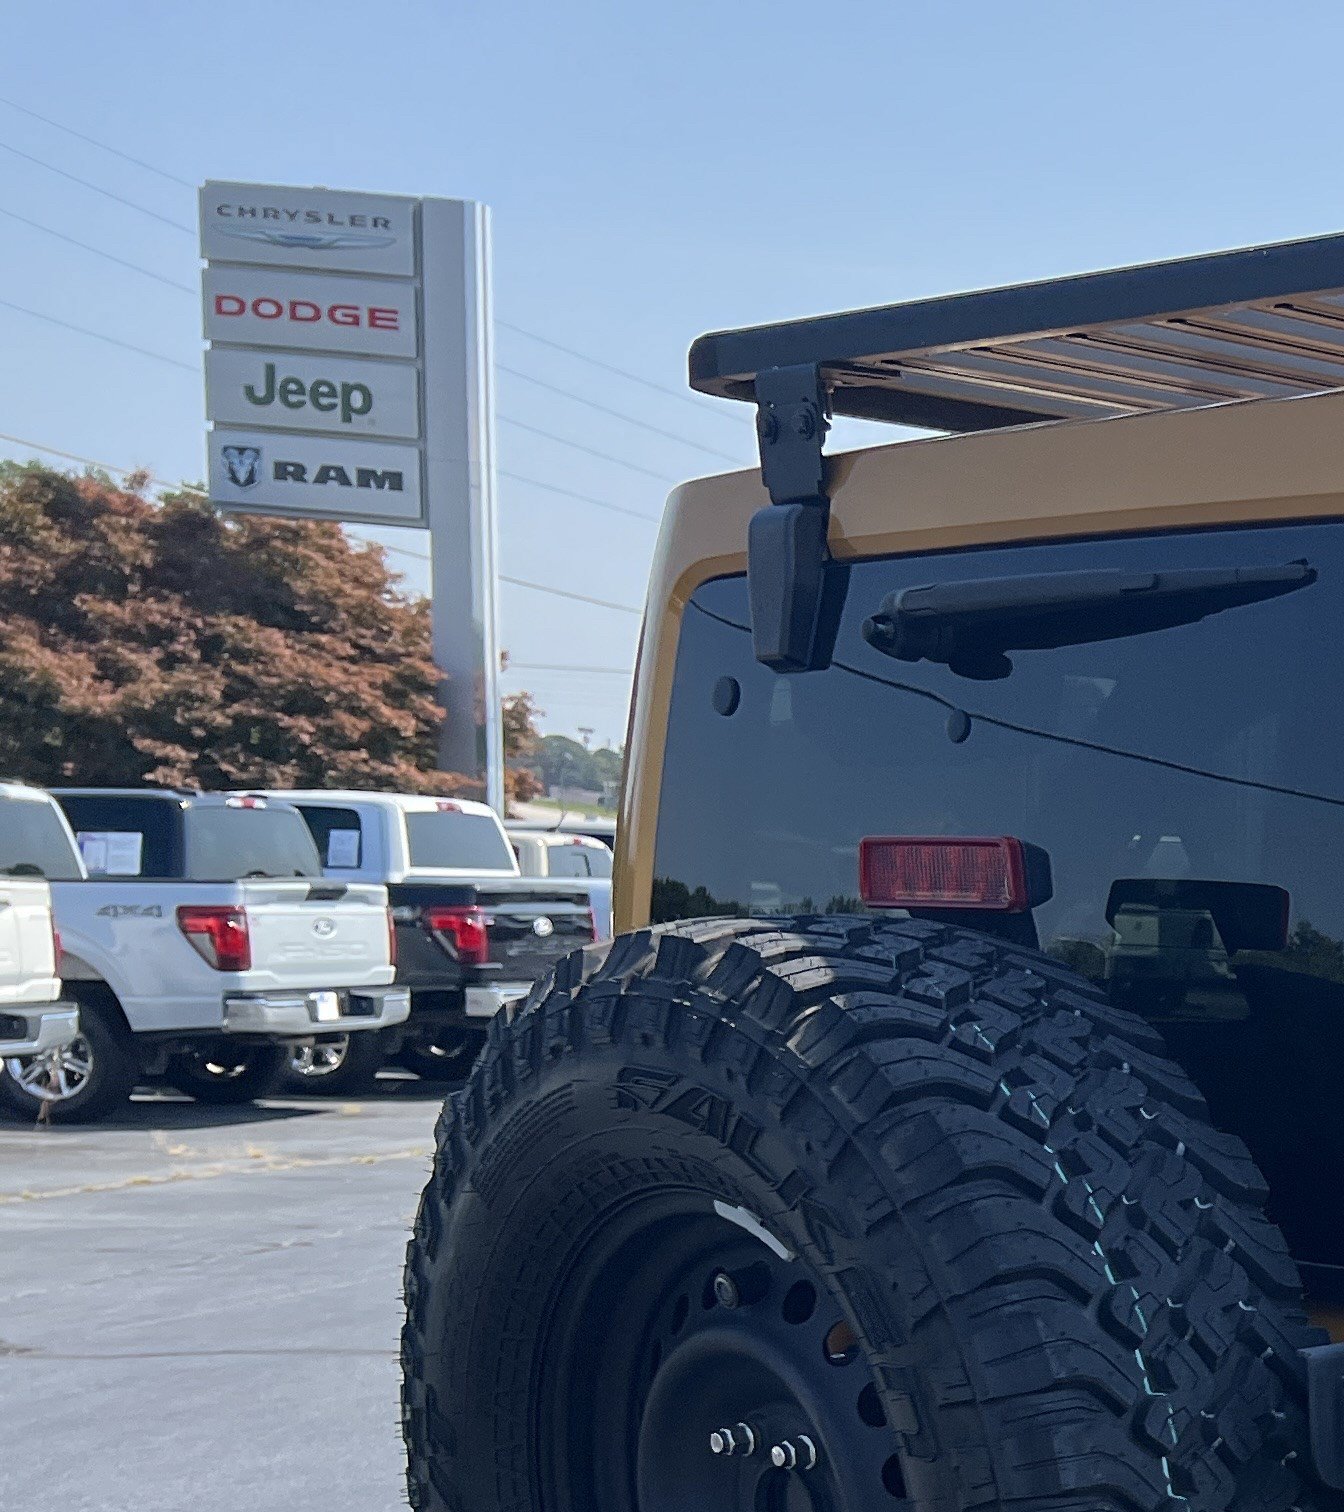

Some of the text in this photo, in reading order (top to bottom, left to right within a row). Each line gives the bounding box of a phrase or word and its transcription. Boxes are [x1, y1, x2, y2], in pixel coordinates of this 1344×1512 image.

[216, 204, 393, 230] CHRYSLER
[214, 294, 400, 331] DODGE
[243, 363, 373, 423] Jeep
[273, 460, 404, 491] RAM
